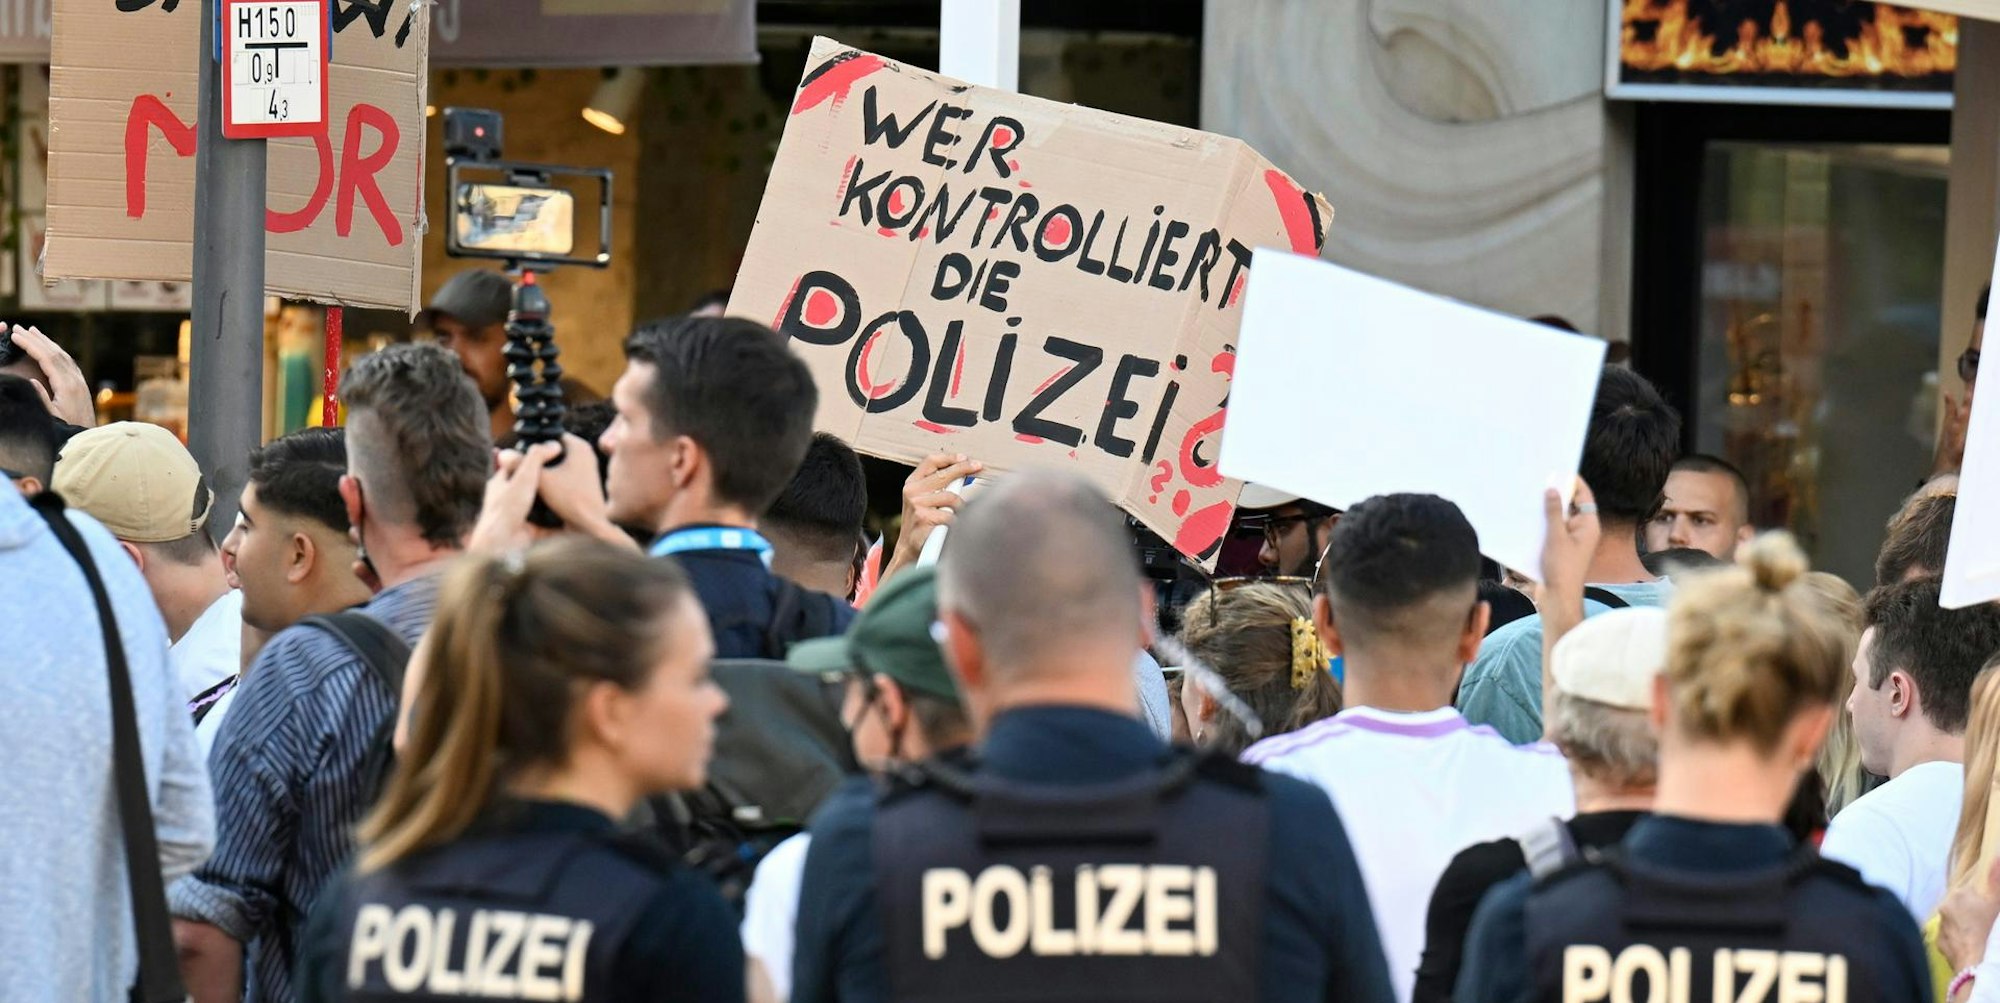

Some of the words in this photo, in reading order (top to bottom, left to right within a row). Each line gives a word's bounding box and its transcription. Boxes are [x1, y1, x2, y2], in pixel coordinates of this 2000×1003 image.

[239, 7, 295, 38] H150
[863, 86, 1025, 179] WER
[931, 252, 1022, 312] DIE
[347, 903, 594, 1003] POLIZEI
[921, 864, 1218, 960] POLIZEI
